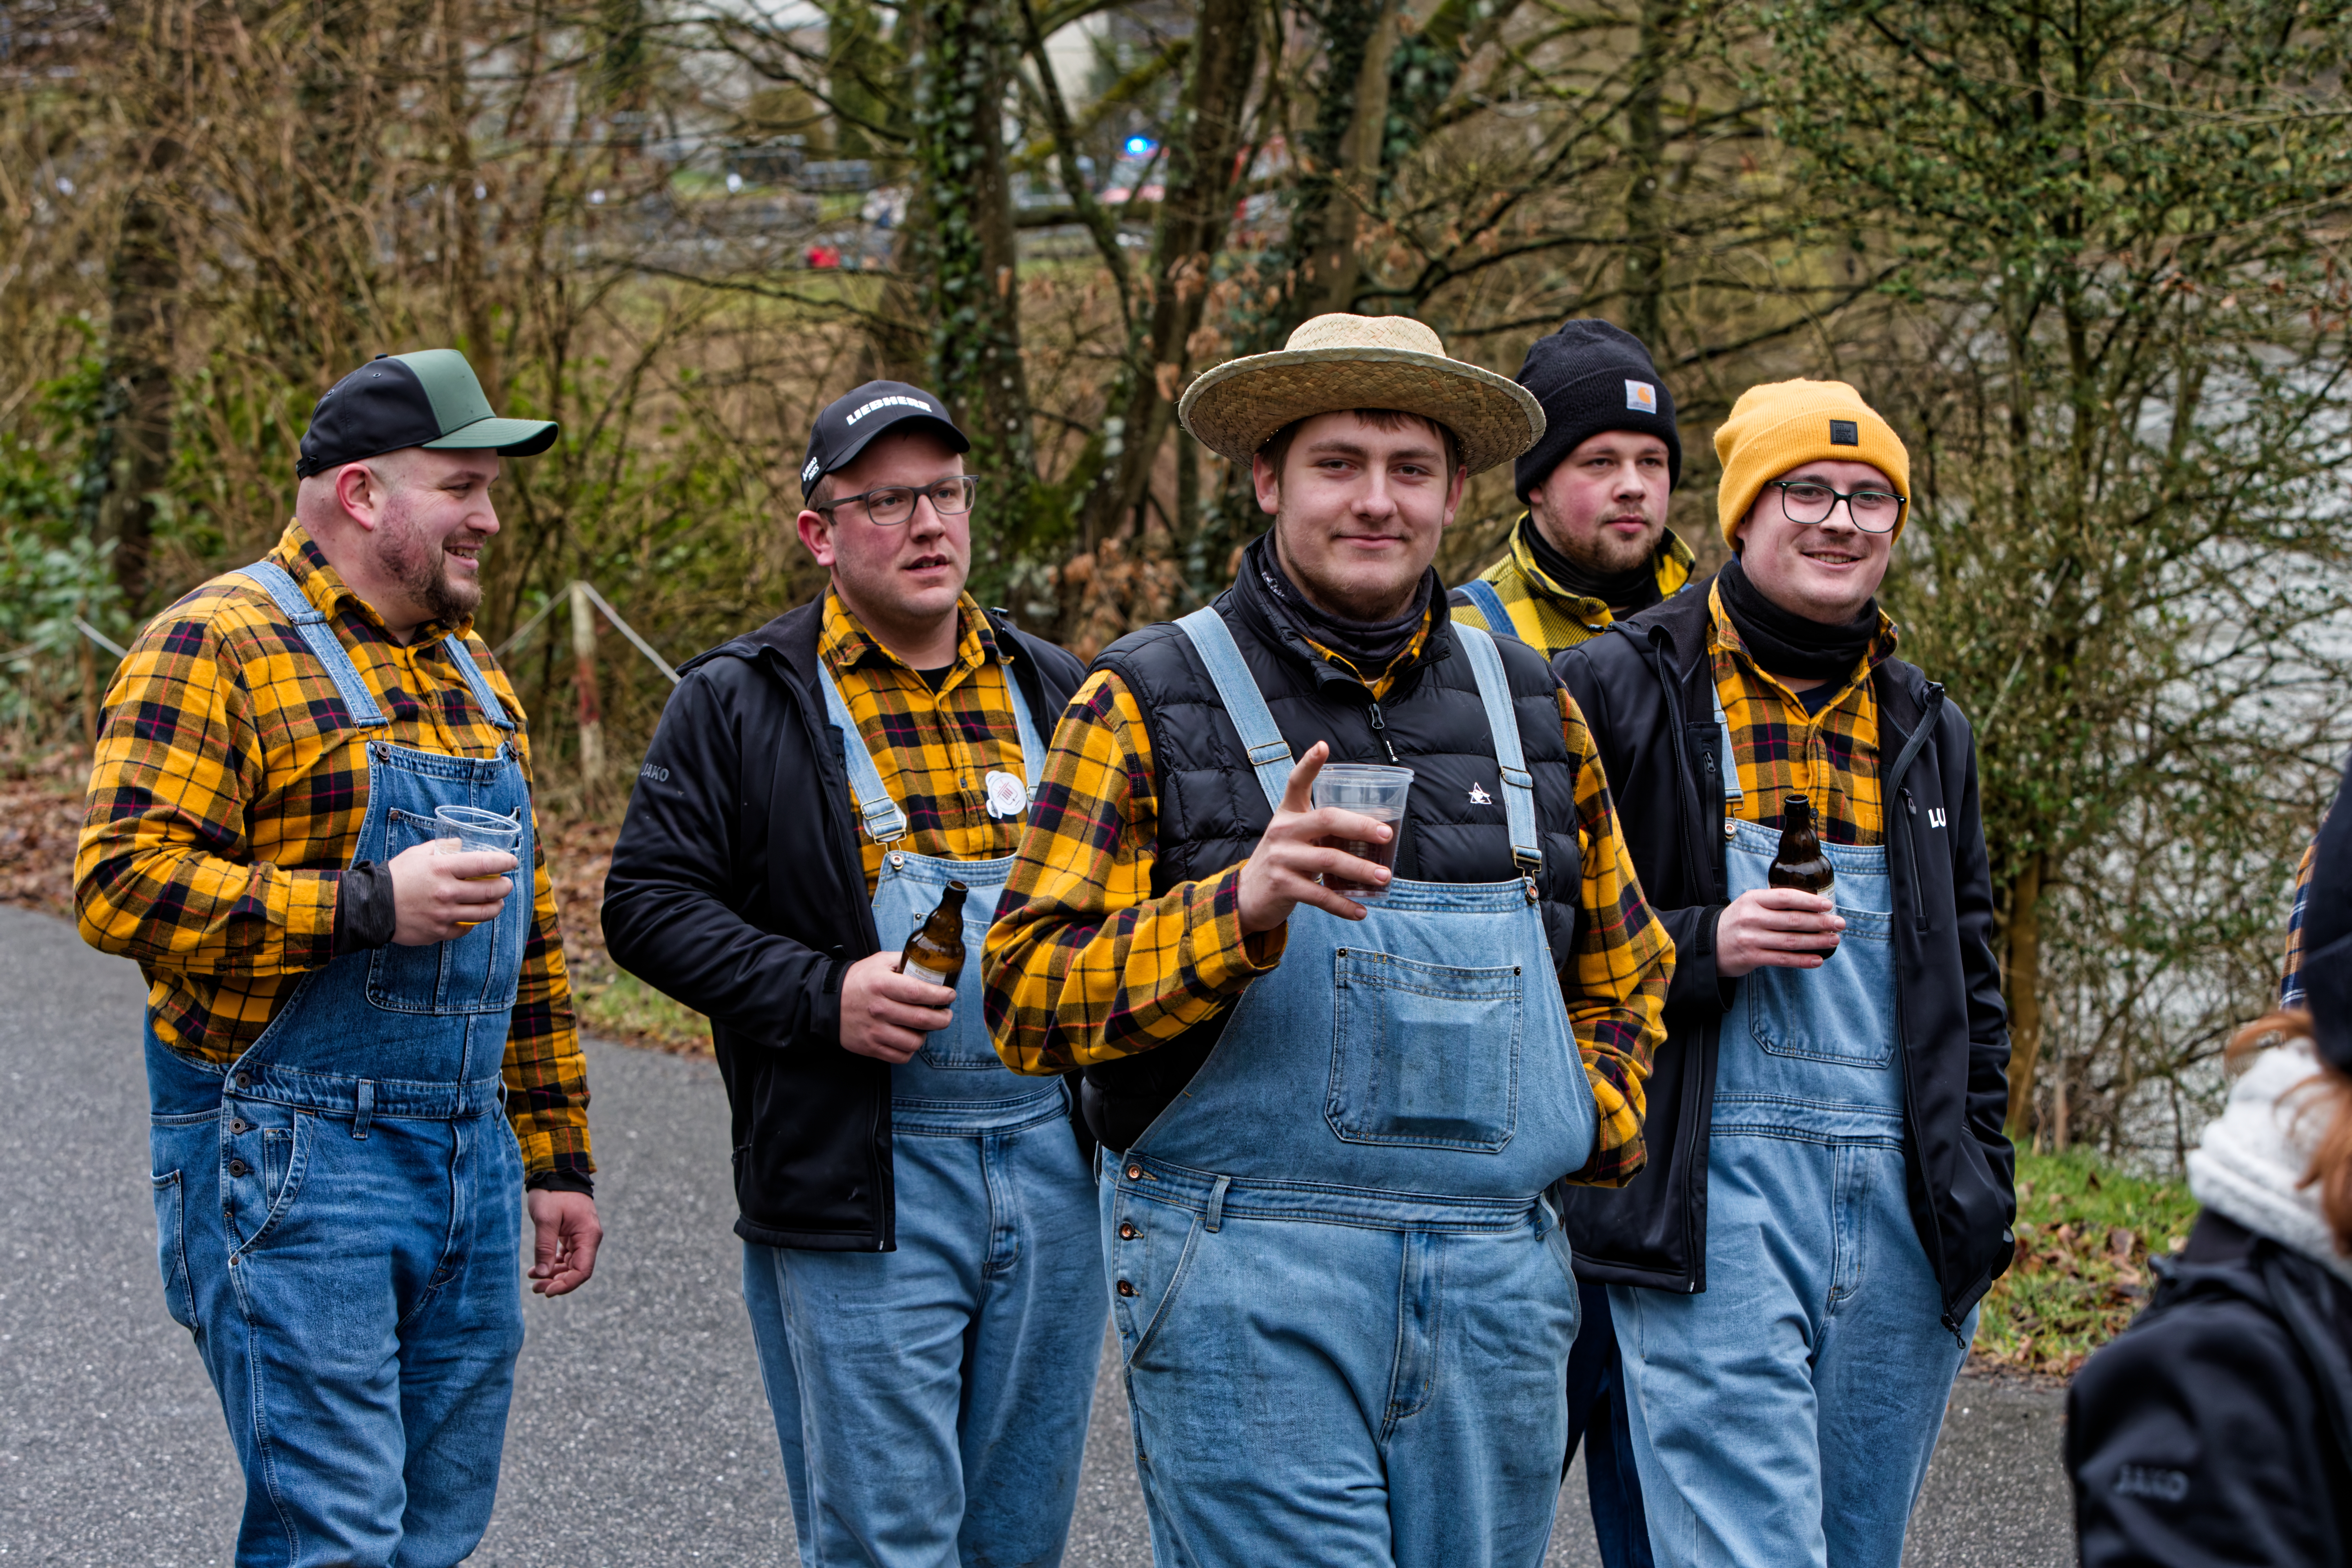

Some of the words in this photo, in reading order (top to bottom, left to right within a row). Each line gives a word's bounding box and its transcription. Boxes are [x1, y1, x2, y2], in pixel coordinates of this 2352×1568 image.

[846, 396, 932, 426] LIEBHERR
[641, 763, 669, 782] JAKO
[1928, 808, 1946, 828] LU
